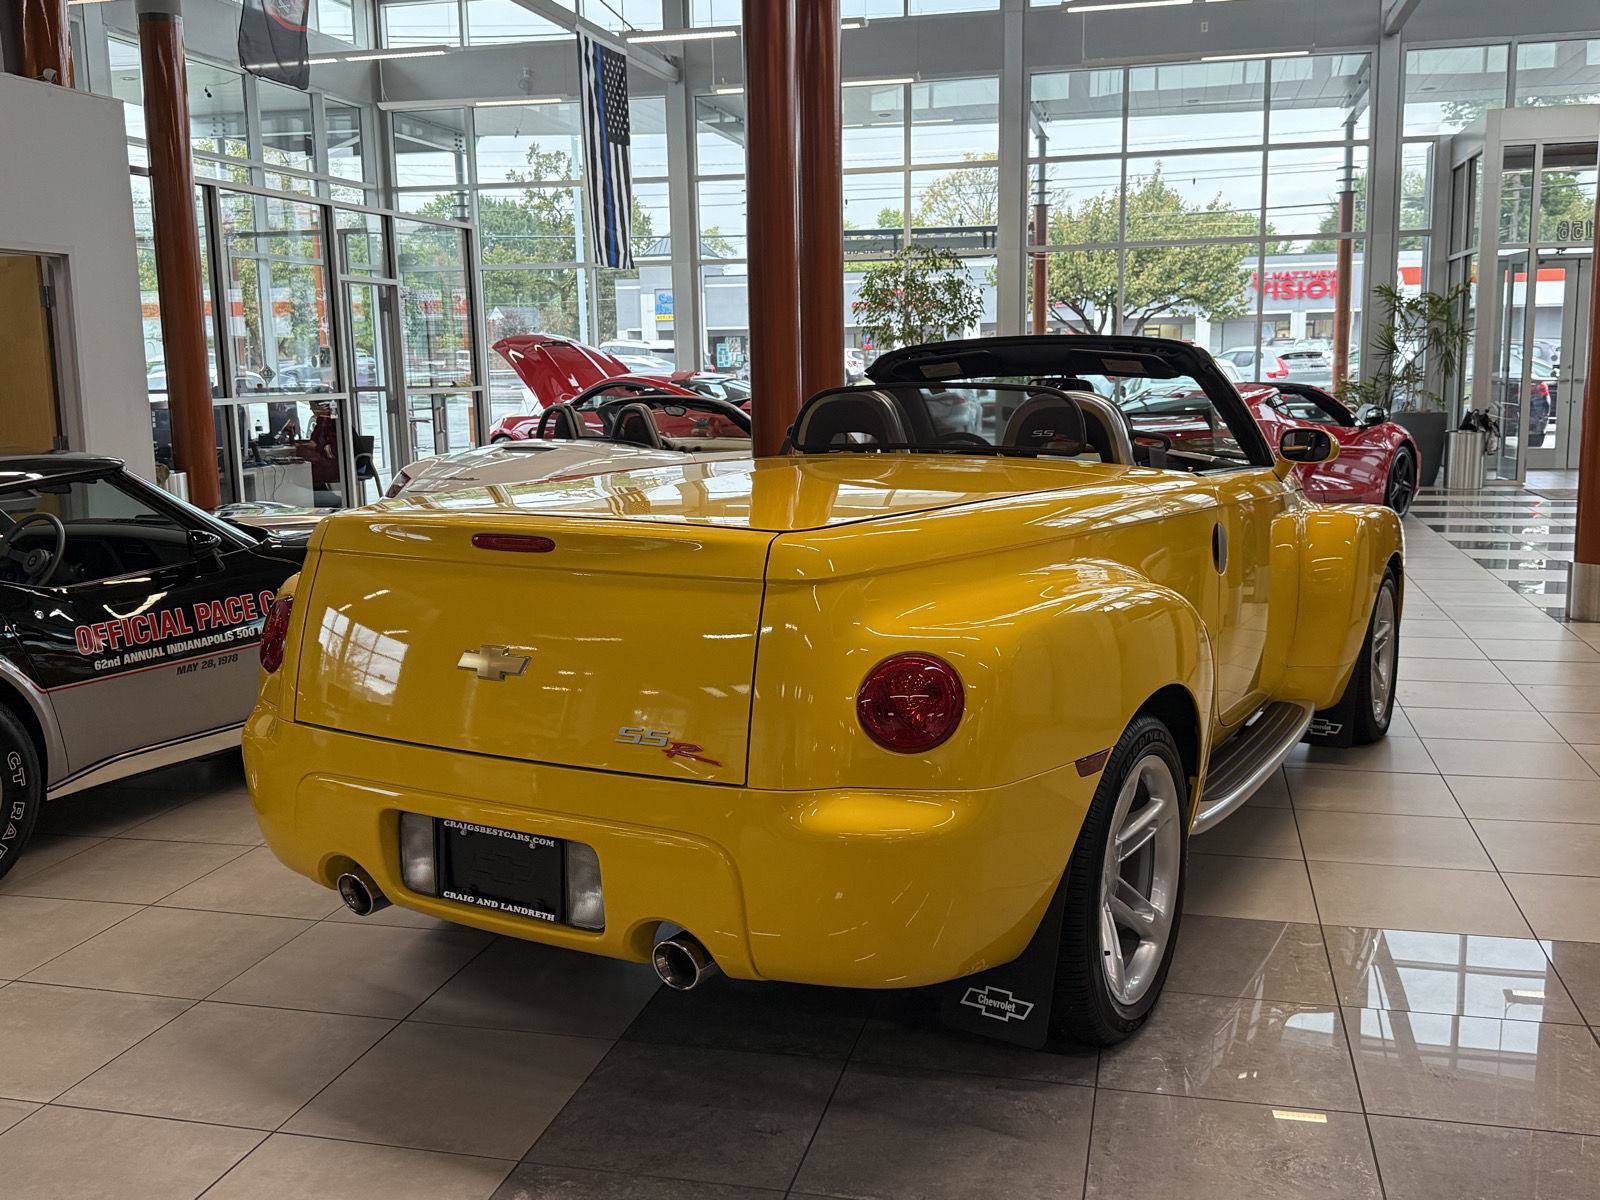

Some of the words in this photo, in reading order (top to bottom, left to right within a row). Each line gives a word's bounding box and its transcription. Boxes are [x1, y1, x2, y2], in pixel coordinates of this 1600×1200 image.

[1271, 270, 1338, 281] MATTHEW
[74, 607, 194, 656] OFFICIAL
[194, 593, 258, 632] PACE
[94, 655, 121, 671] 62nd
[123, 646, 166, 666] ANNUAL
[167, 630, 235, 655] INDIANAPOLIS
[236, 627, 256, 639] 500
[176, 659, 200, 676] MAY
[201, 658, 218, 670] 28,
[218, 653, 239, 667] 1978
[7, 751, 26, 786] GT
[443, 820, 555, 847] CRAIGSBESTCARS.COM
[443, 890, 475, 903] CRAIG
[476, 898, 499, 908] AND
[500, 903, 555, 921] LANDRETH
[977, 994, 1016, 1013] Chevrolet
